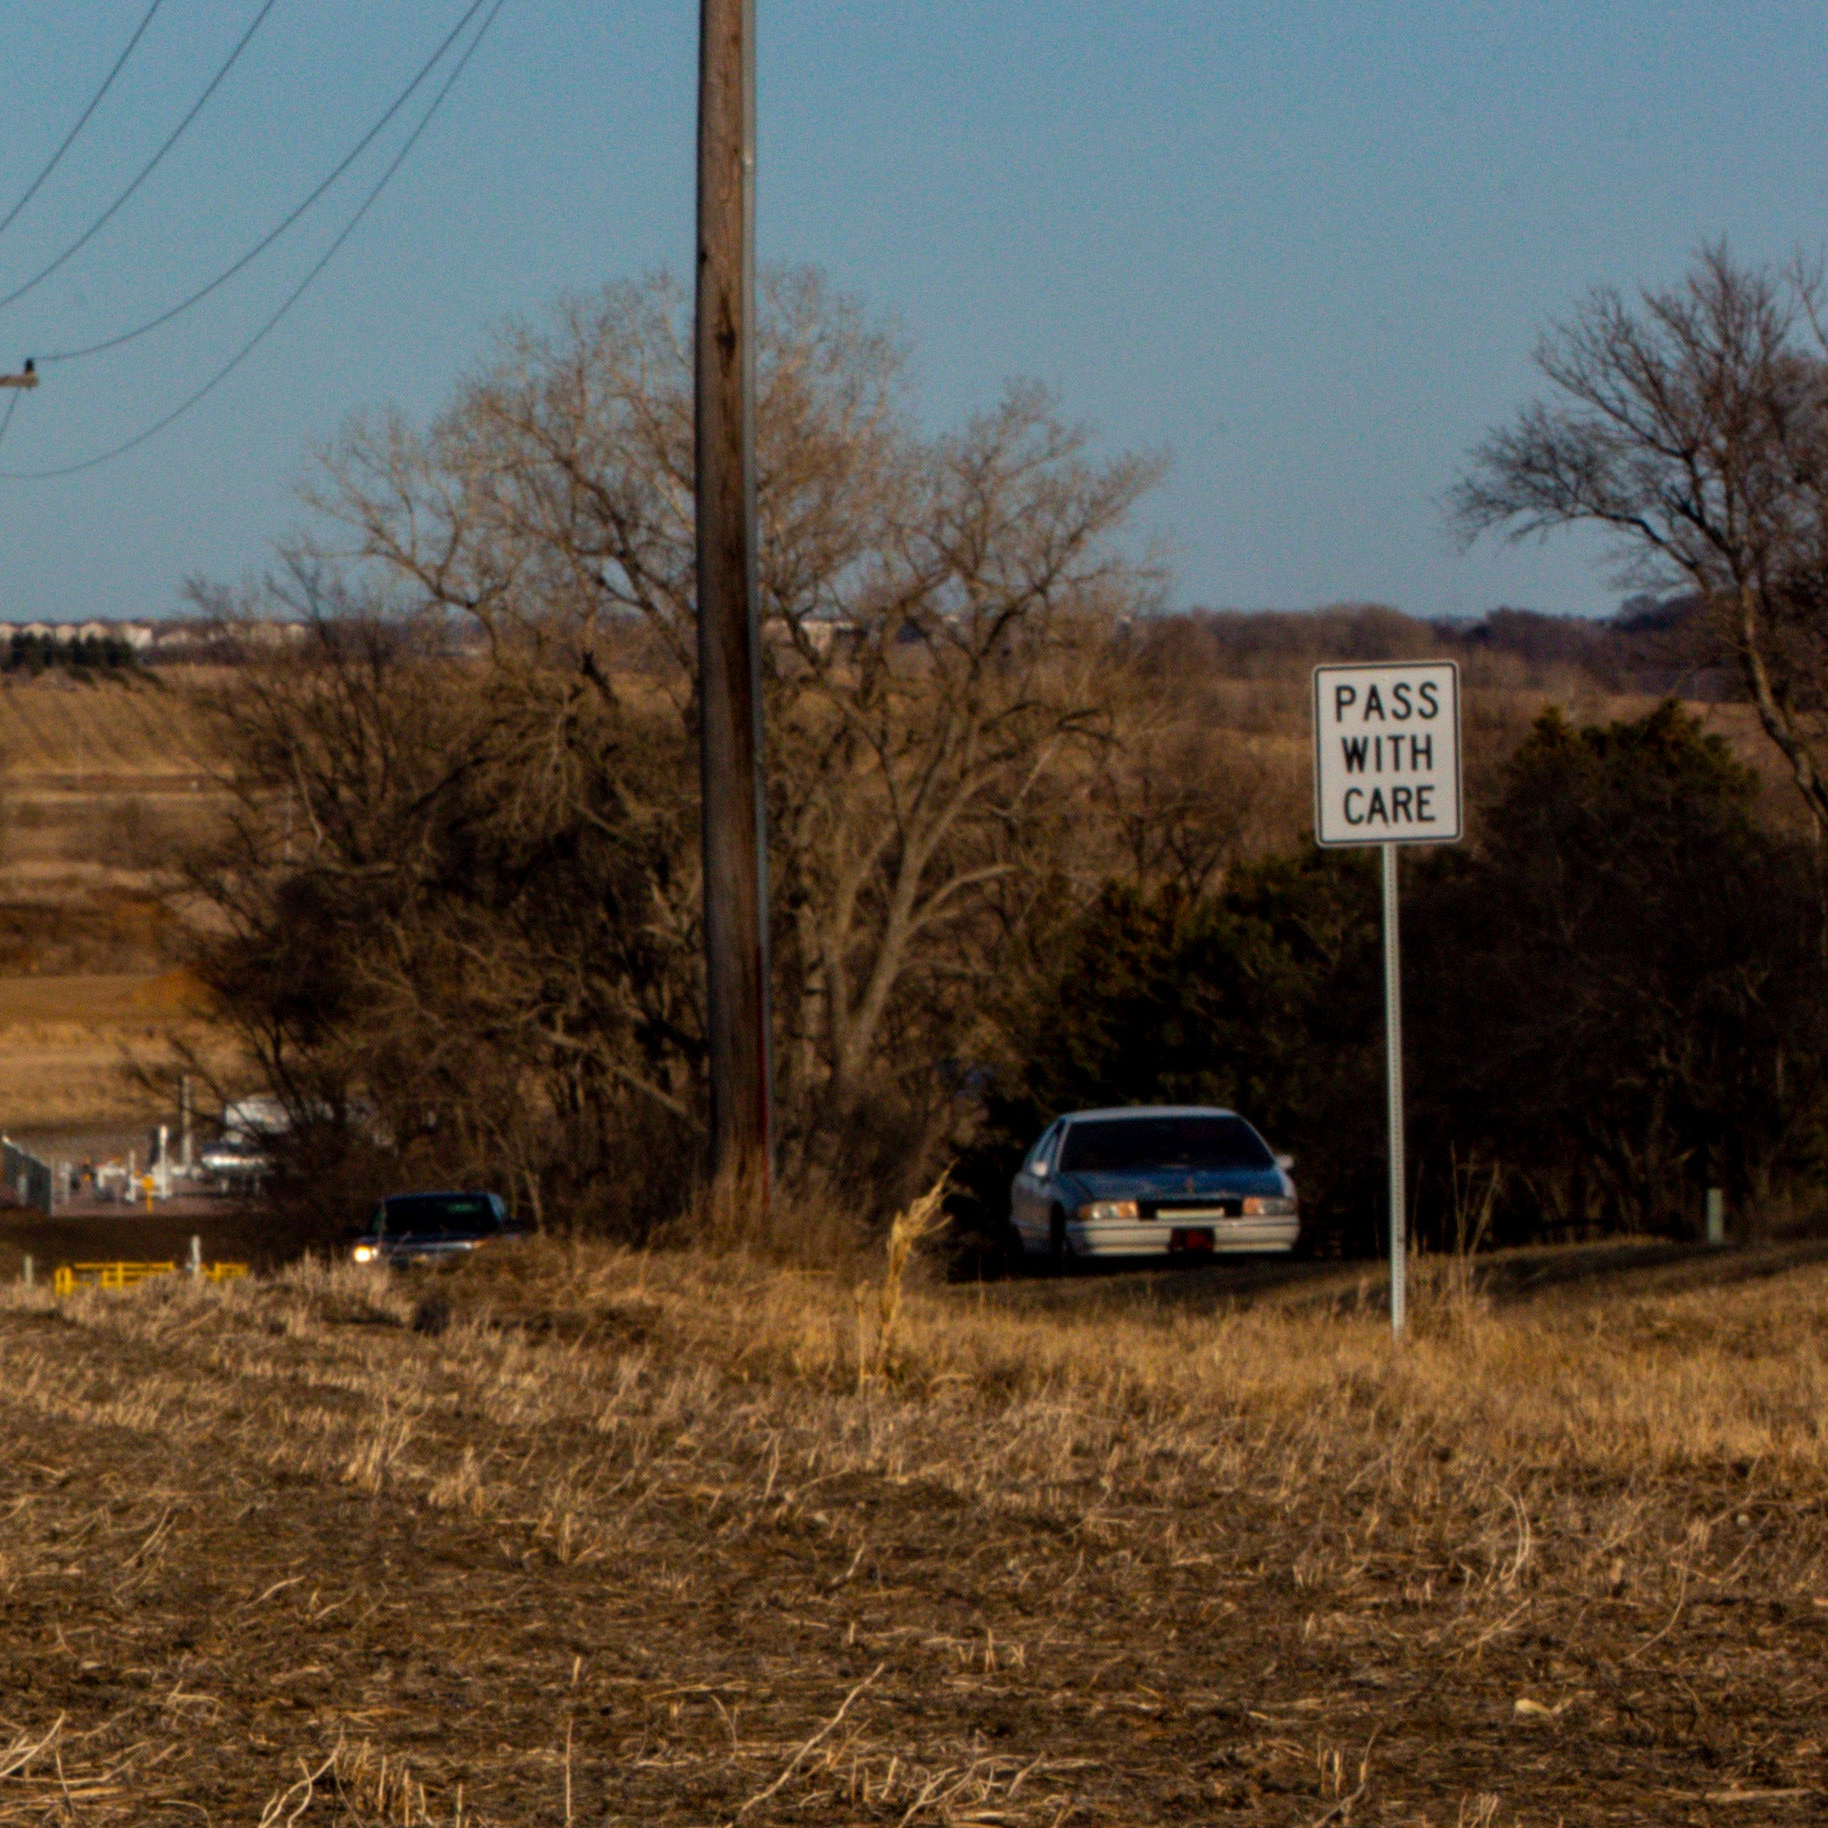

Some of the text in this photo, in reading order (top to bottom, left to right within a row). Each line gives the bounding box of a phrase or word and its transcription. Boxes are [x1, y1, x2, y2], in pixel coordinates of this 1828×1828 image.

[1336, 681, 1439, 722] PASS
[1341, 734, 1433, 773] WITH
[1344, 785, 1436, 826] CARE
